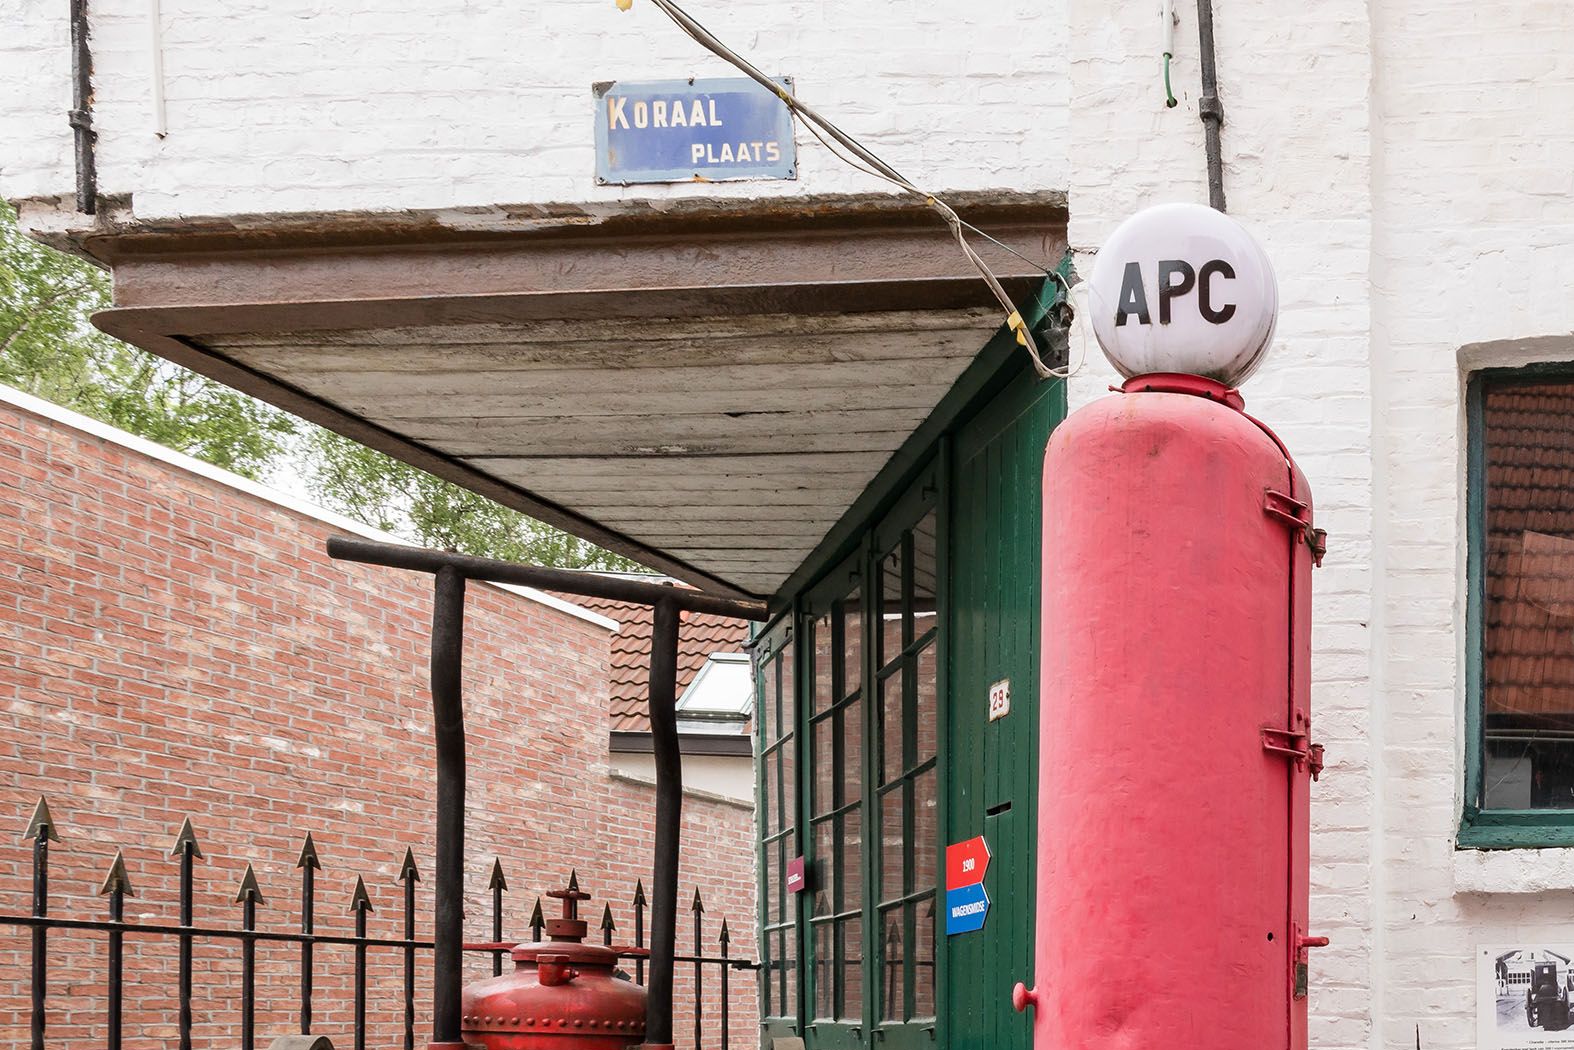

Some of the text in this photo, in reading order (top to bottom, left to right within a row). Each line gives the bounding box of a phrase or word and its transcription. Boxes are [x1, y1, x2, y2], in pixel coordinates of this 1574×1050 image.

[608, 96, 722, 130] KORAAL
[691, 141, 780, 164] PLAATS
[1115, 259, 1236, 326] APC
[993, 689, 1004, 711] 29
[962, 858, 975, 873] 1900
[951, 900, 985, 918] WAGENSMIDSE
